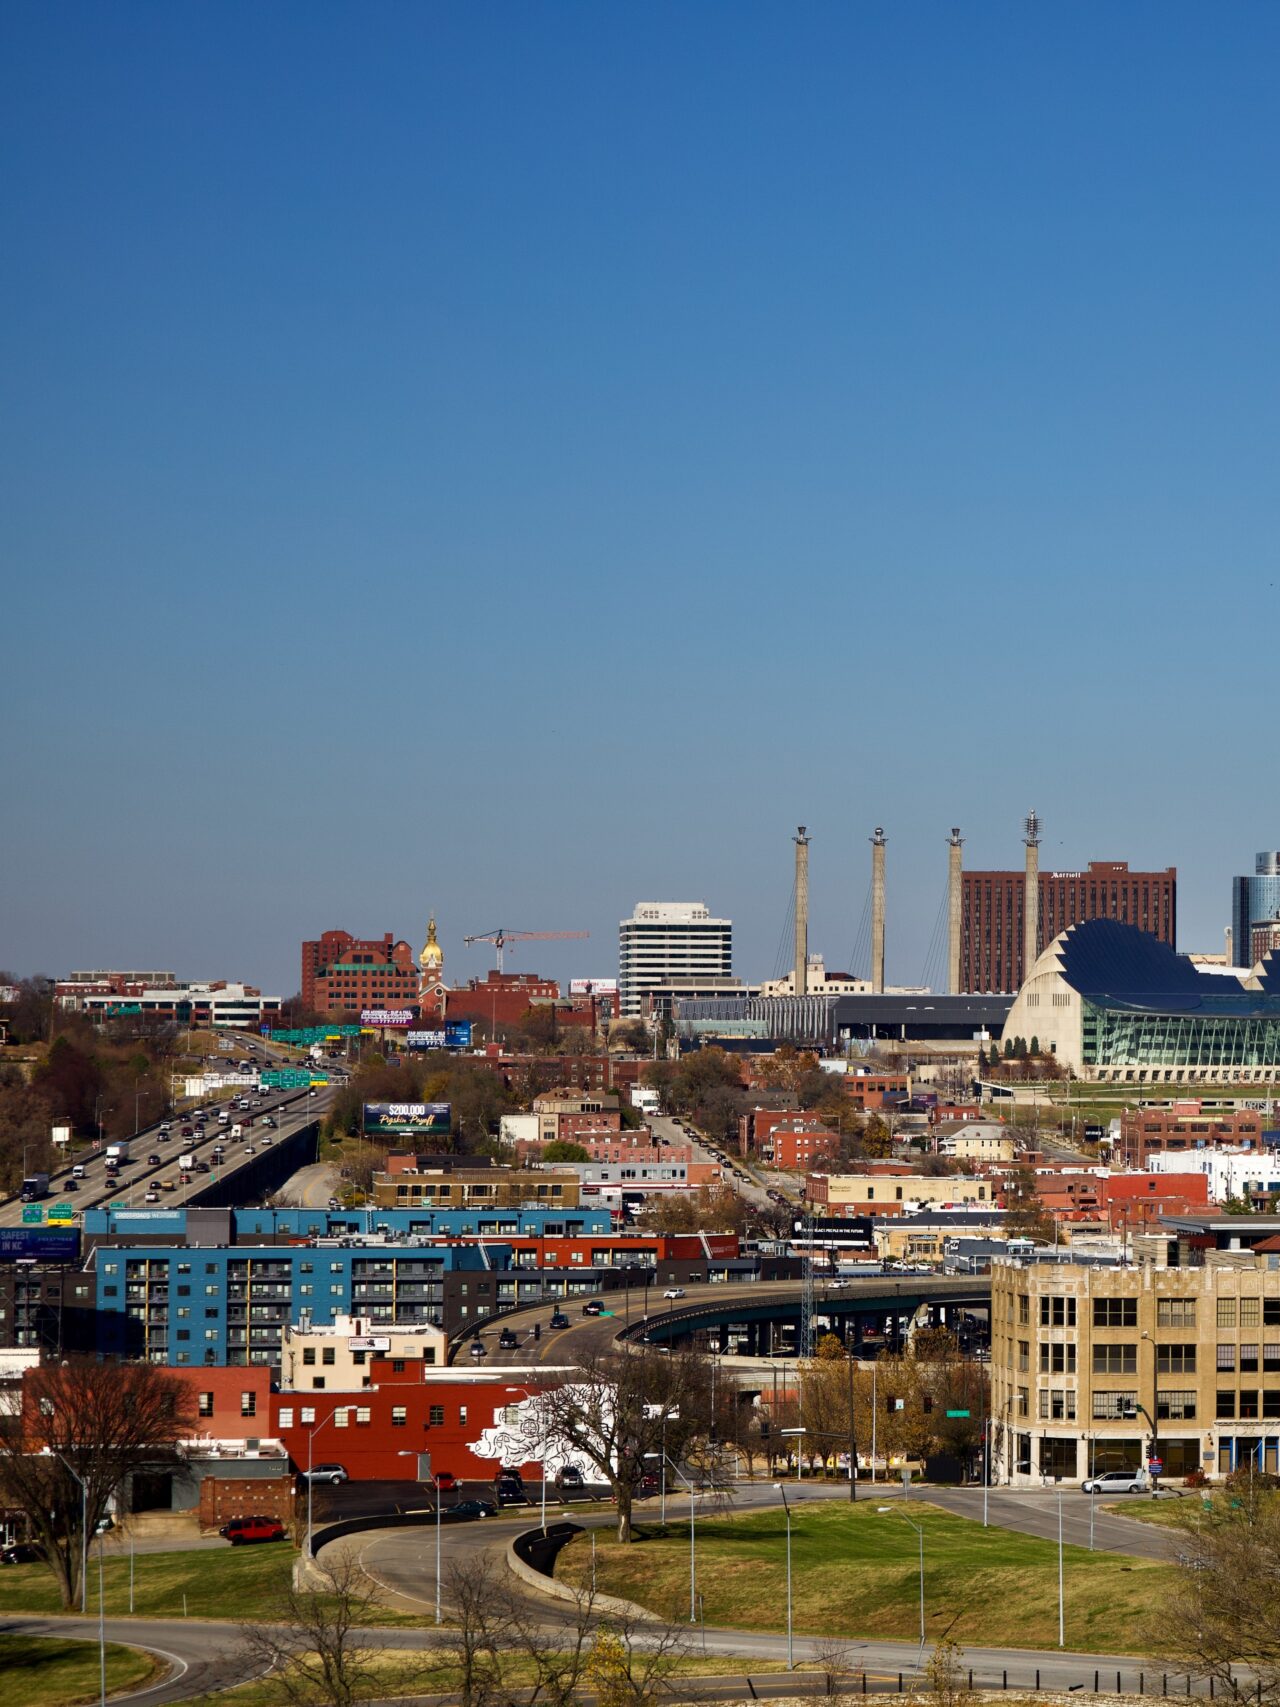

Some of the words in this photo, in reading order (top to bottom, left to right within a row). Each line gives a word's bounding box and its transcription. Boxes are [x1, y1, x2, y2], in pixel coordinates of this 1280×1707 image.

[389, 1104, 425, 1116] $200,000
[379, 1114, 407, 1125] Pigskin
[409, 1114, 436, 1126] Payoff
[1, 1231, 29, 1240] SAFEST
[2, 1241, 10, 1250] IN
[12, 1241, 23, 1250] KC
